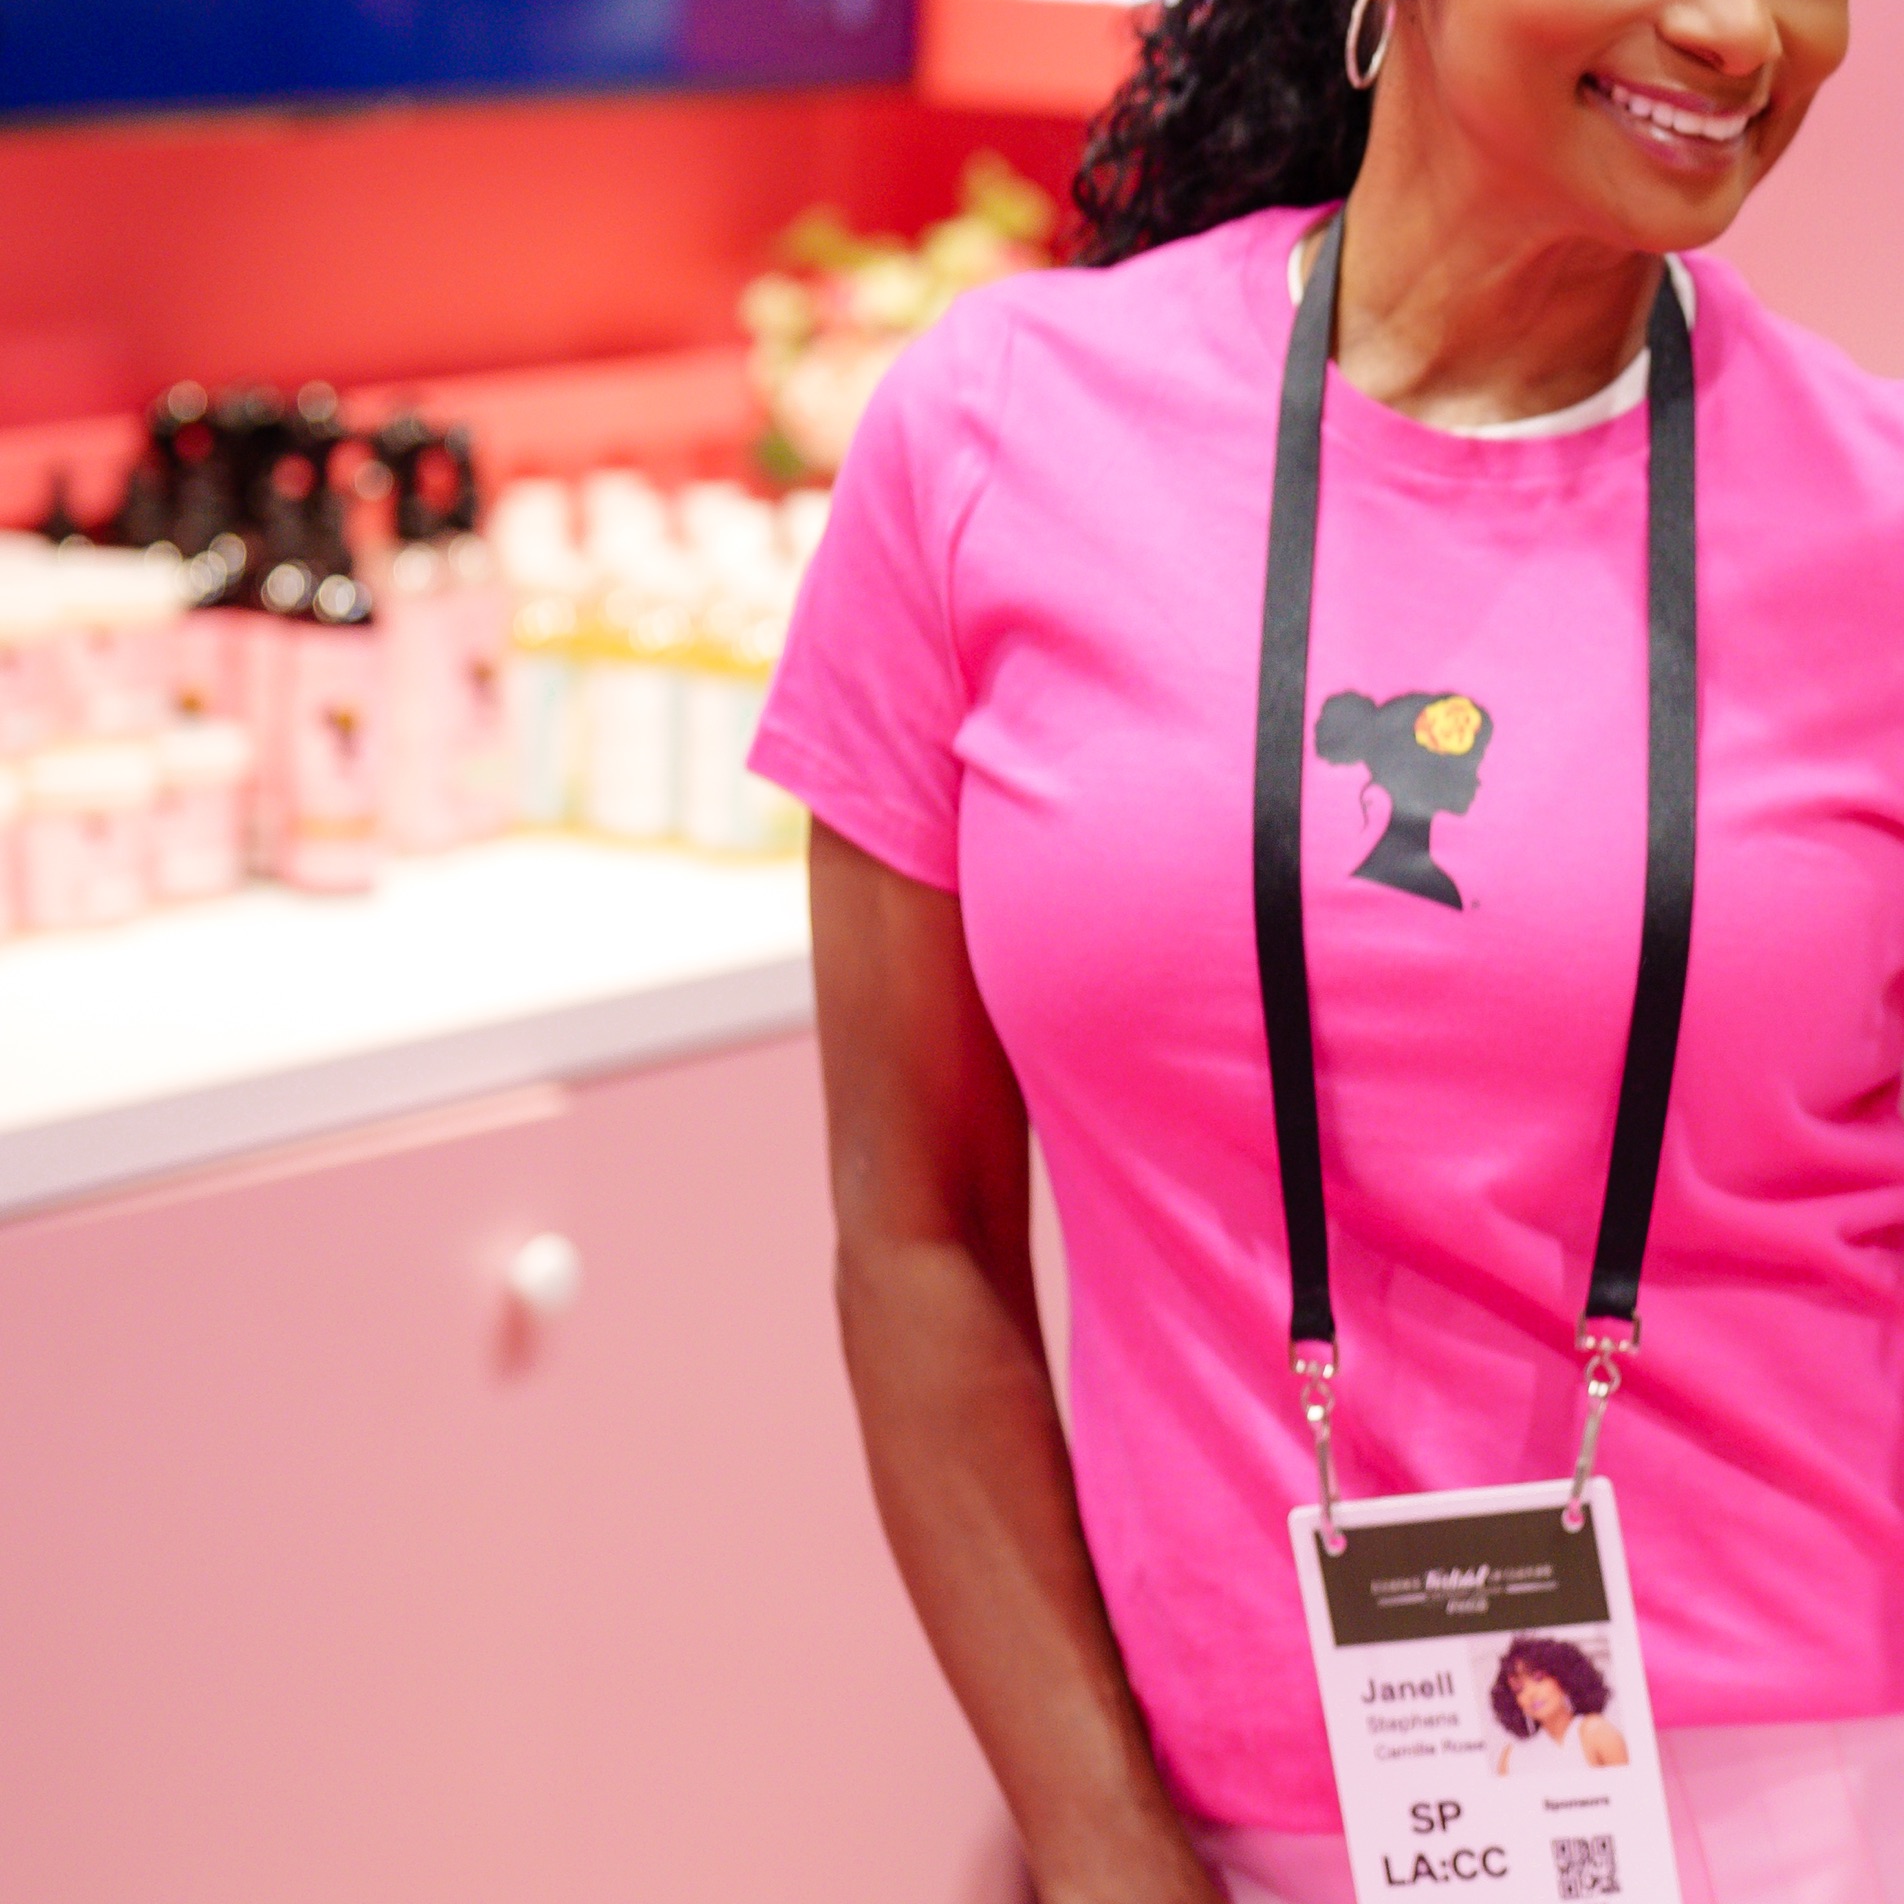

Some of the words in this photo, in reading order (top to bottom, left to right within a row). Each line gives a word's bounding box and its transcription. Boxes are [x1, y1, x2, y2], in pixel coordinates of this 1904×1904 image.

[1361, 1670, 1455, 1704] Janell
[1410, 1800, 1462, 1835] SP
[1382, 1846, 1509, 1888] LA:CC
